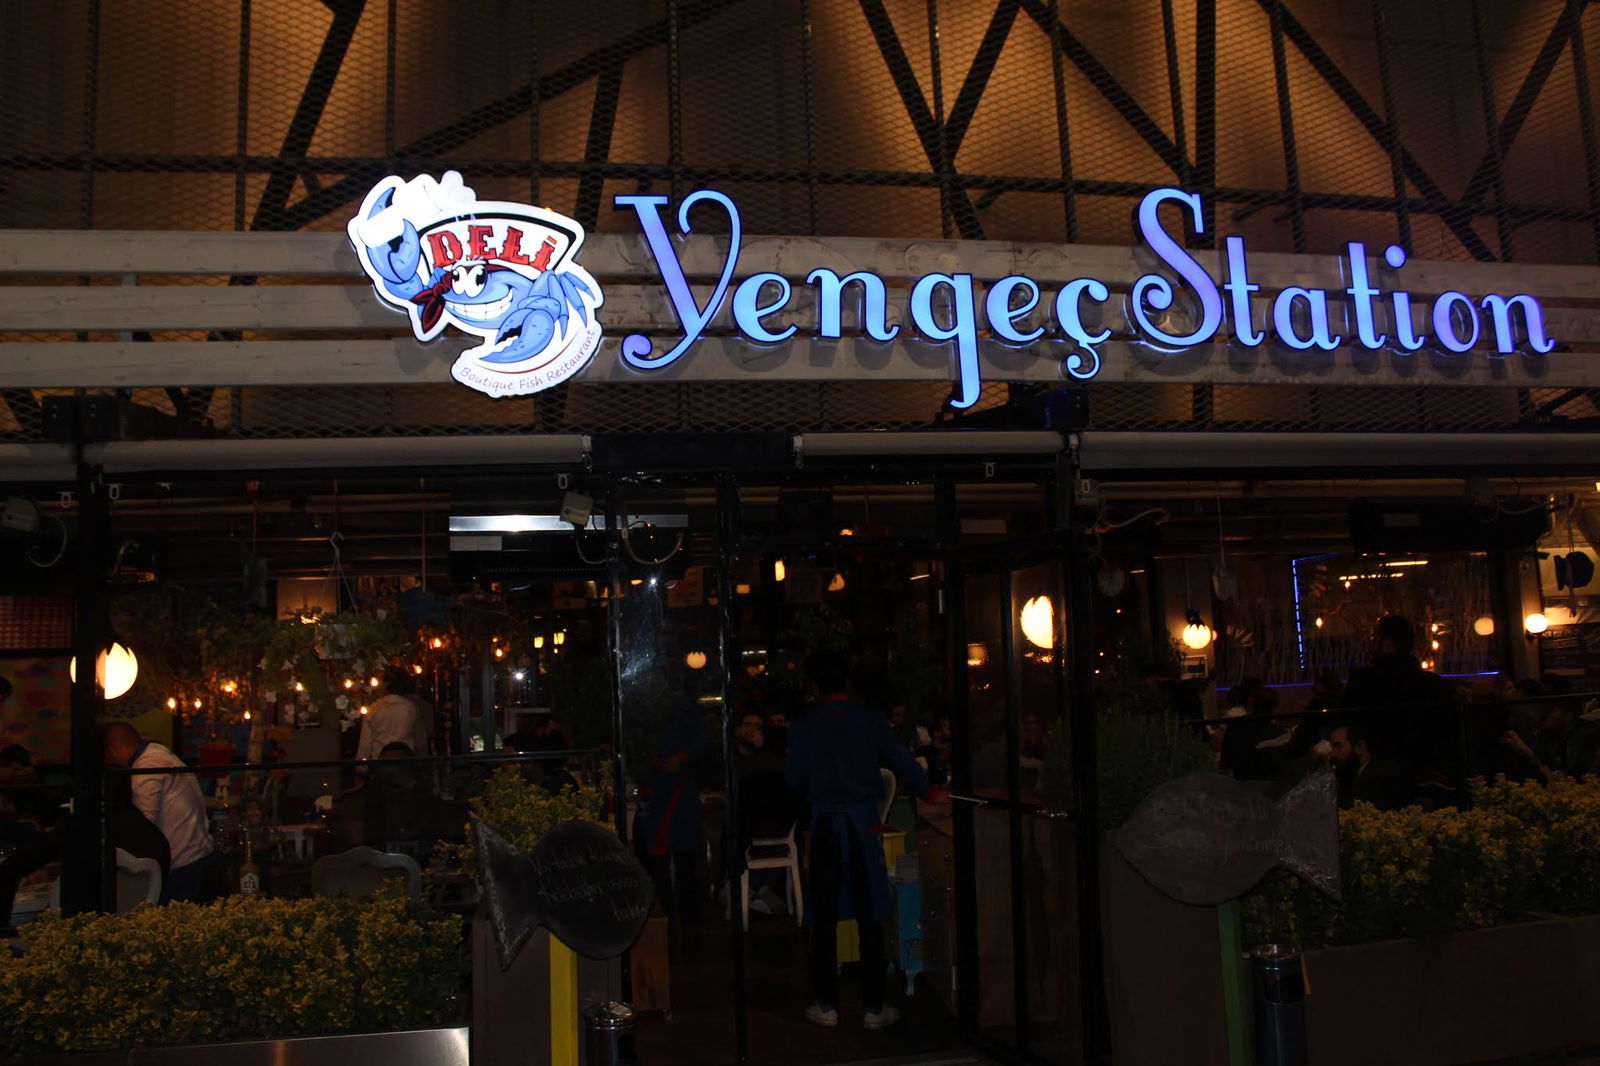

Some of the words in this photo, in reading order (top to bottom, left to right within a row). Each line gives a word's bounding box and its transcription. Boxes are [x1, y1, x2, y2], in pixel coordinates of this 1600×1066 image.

[1132, 188, 1554, 354] Station
[461, 367, 513, 391] Boutique
[519, 376, 543, 390] Fish
[547, 330, 595, 382] Restaurant
